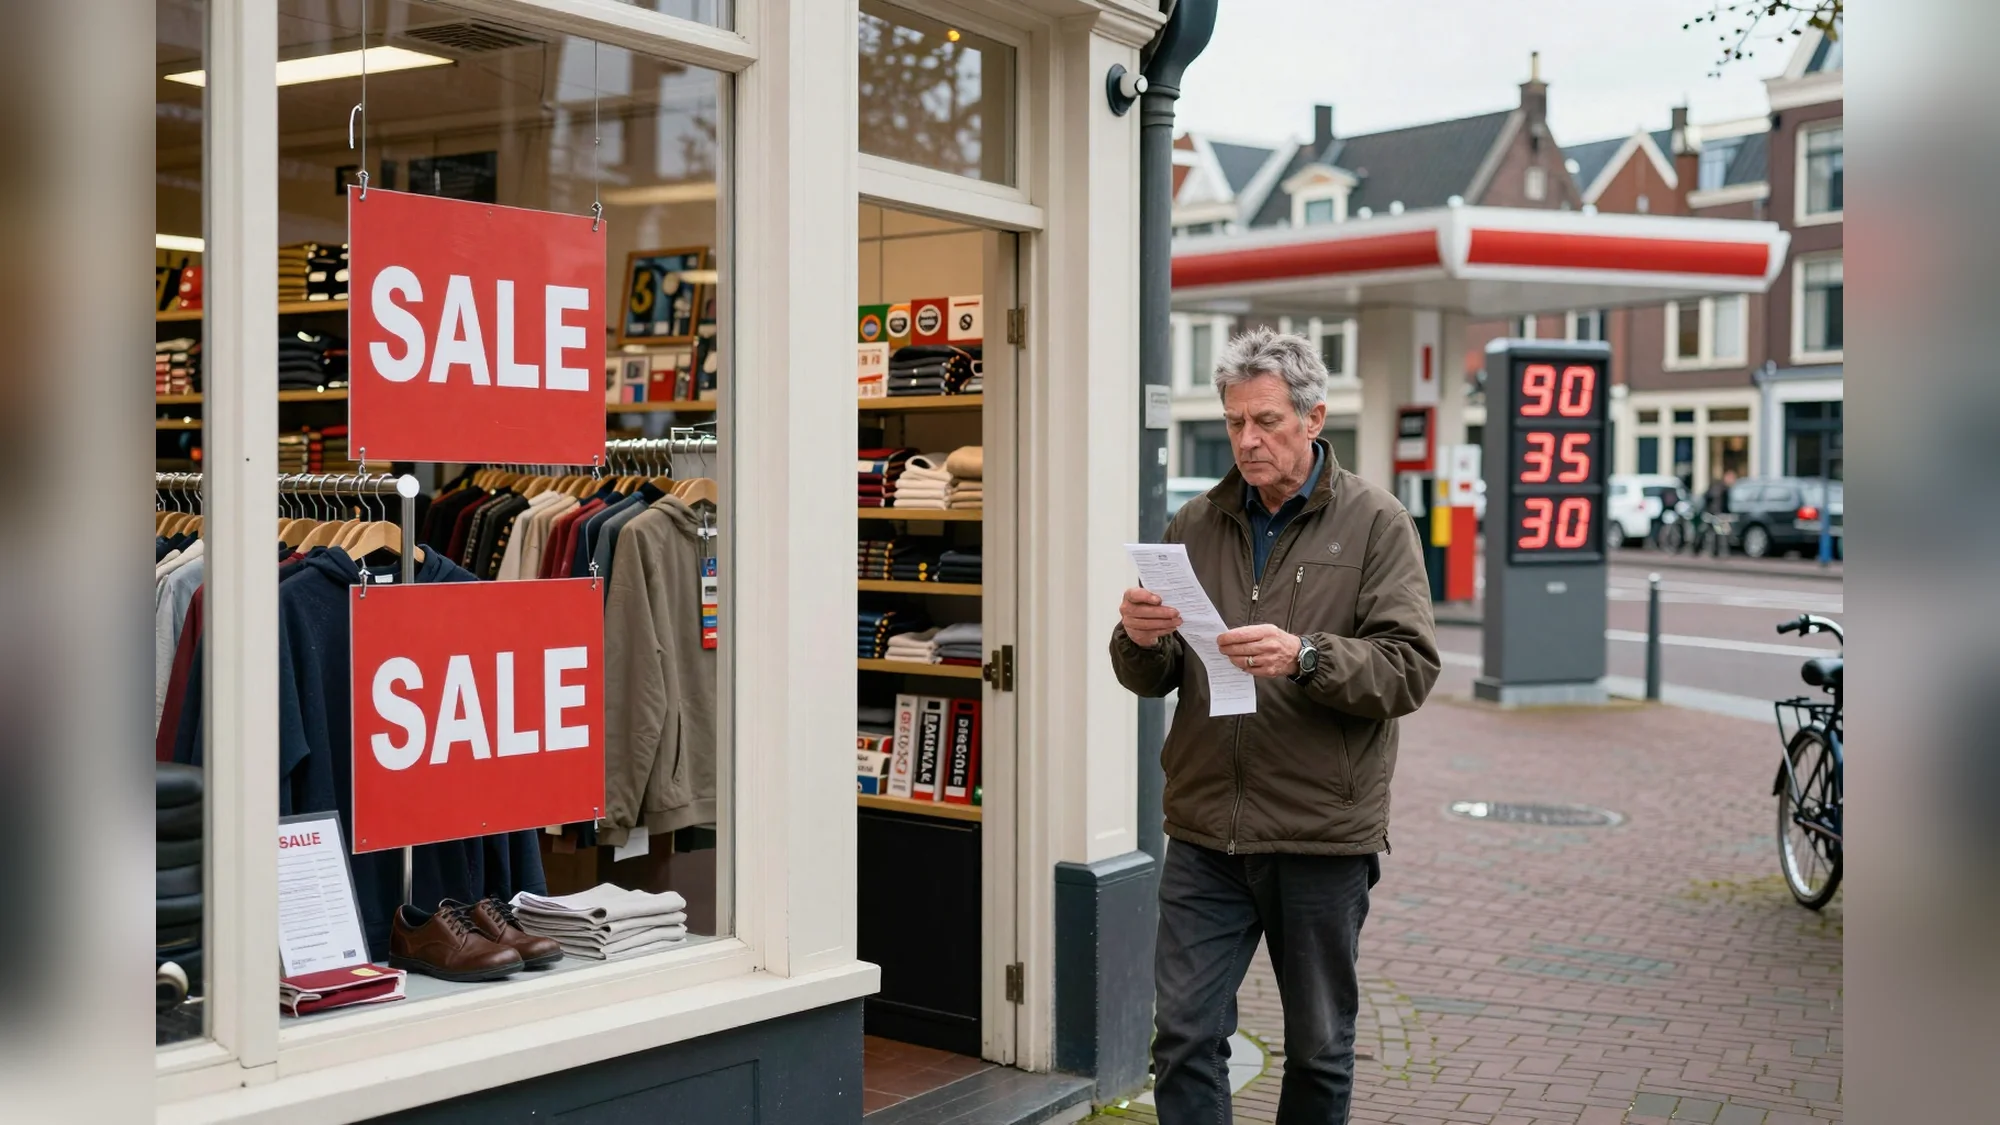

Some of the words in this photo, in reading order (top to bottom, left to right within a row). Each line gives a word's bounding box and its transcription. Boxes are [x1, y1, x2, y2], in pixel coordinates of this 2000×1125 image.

[369, 266, 590, 392] SALE
[1520, 364, 1596, 417] 90
[1520, 432, 1592, 483] 35
[1518, 497, 1592, 549] 30
[371, 647, 590, 771] SALE
